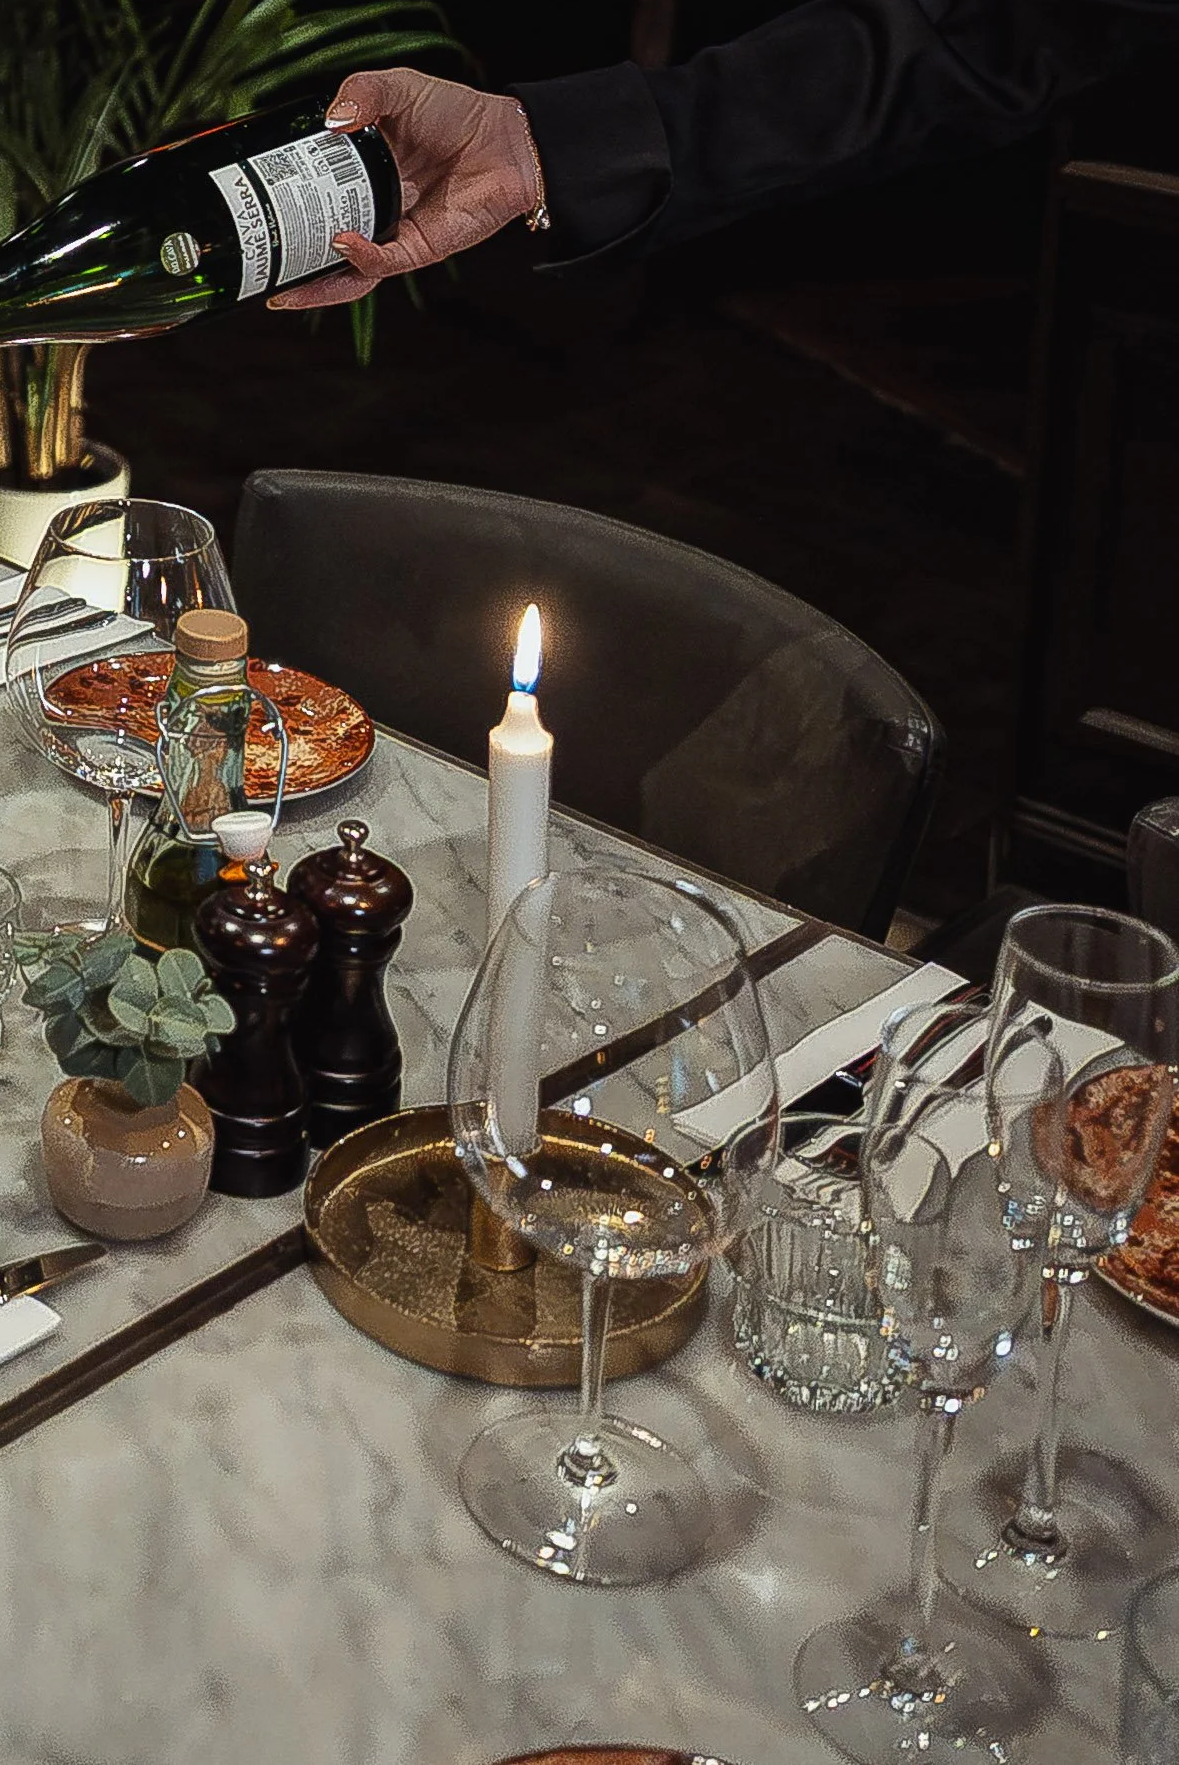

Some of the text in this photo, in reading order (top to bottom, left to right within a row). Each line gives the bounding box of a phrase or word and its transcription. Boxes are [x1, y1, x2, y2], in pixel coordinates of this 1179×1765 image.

[234, 176, 264, 229] SERRA
[237, 210, 256, 261] CAVA
[254, 230, 270, 283] JAUME
